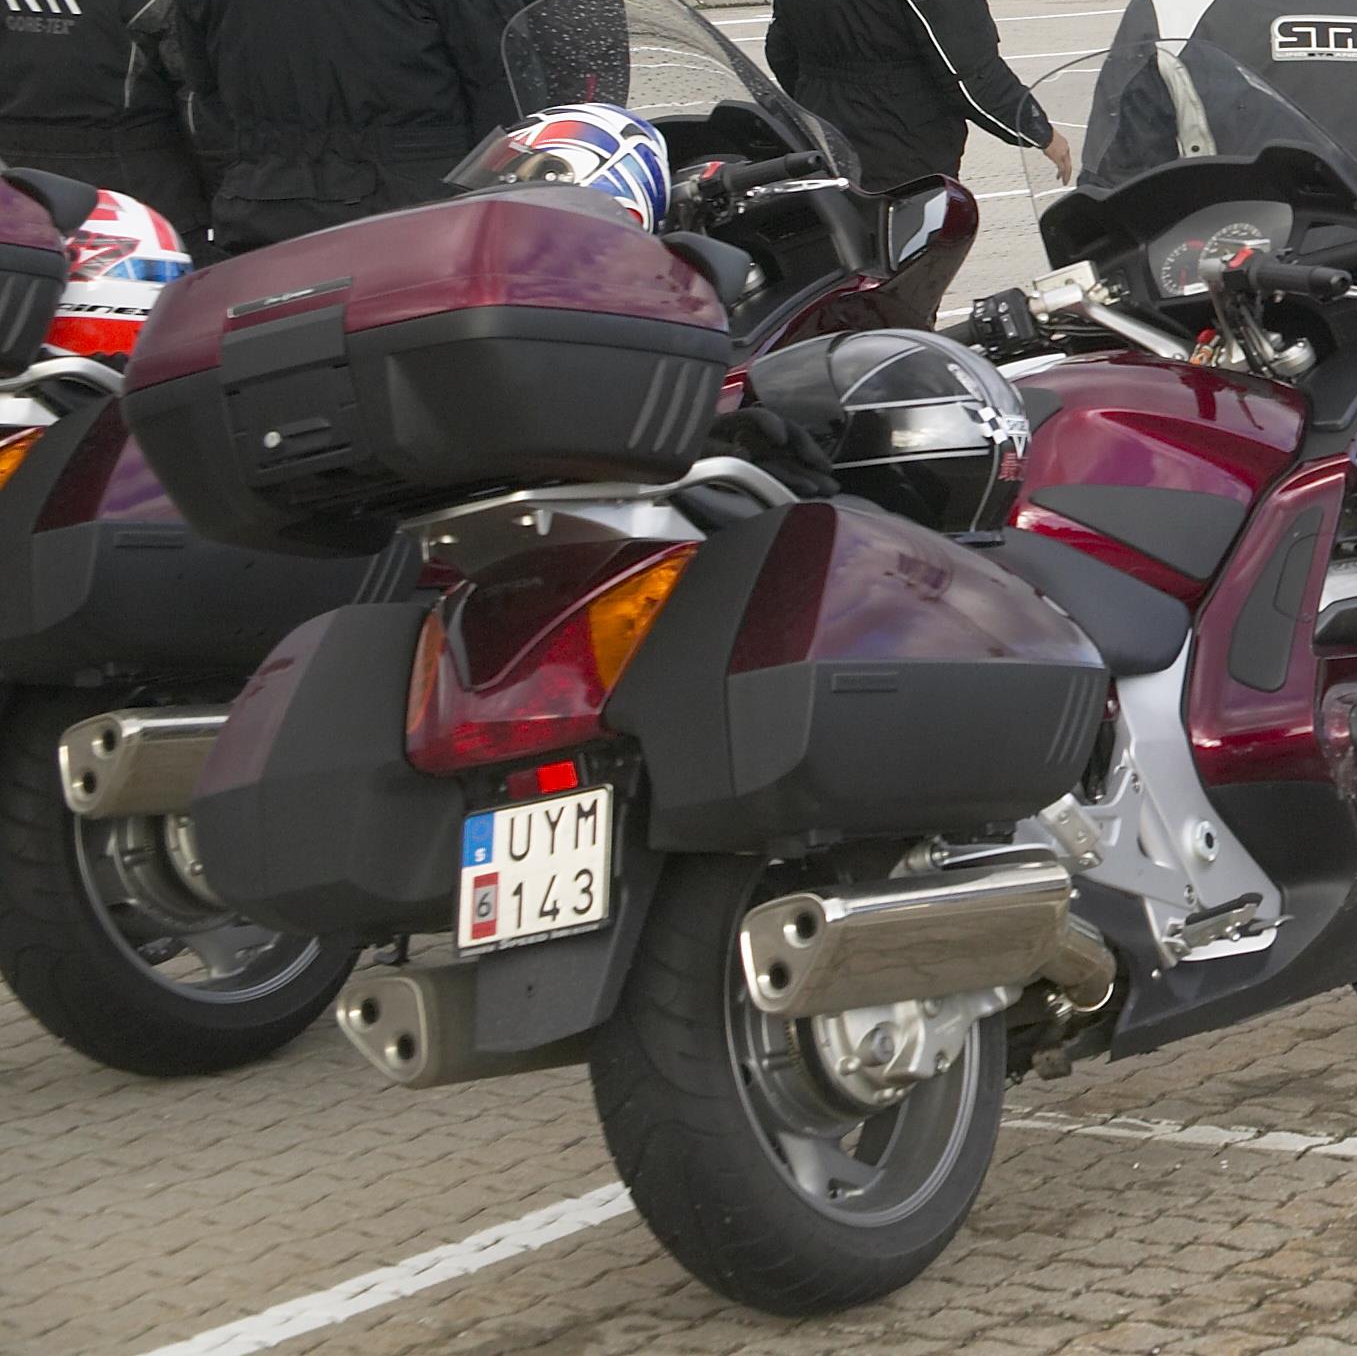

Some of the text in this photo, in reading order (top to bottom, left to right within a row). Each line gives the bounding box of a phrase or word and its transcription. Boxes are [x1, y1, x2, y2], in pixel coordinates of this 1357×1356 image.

[509, 799, 598, 861] UYM
[474, 847, 487, 862] S
[477, 893, 492, 918] 6
[512, 868, 594, 929] 143
